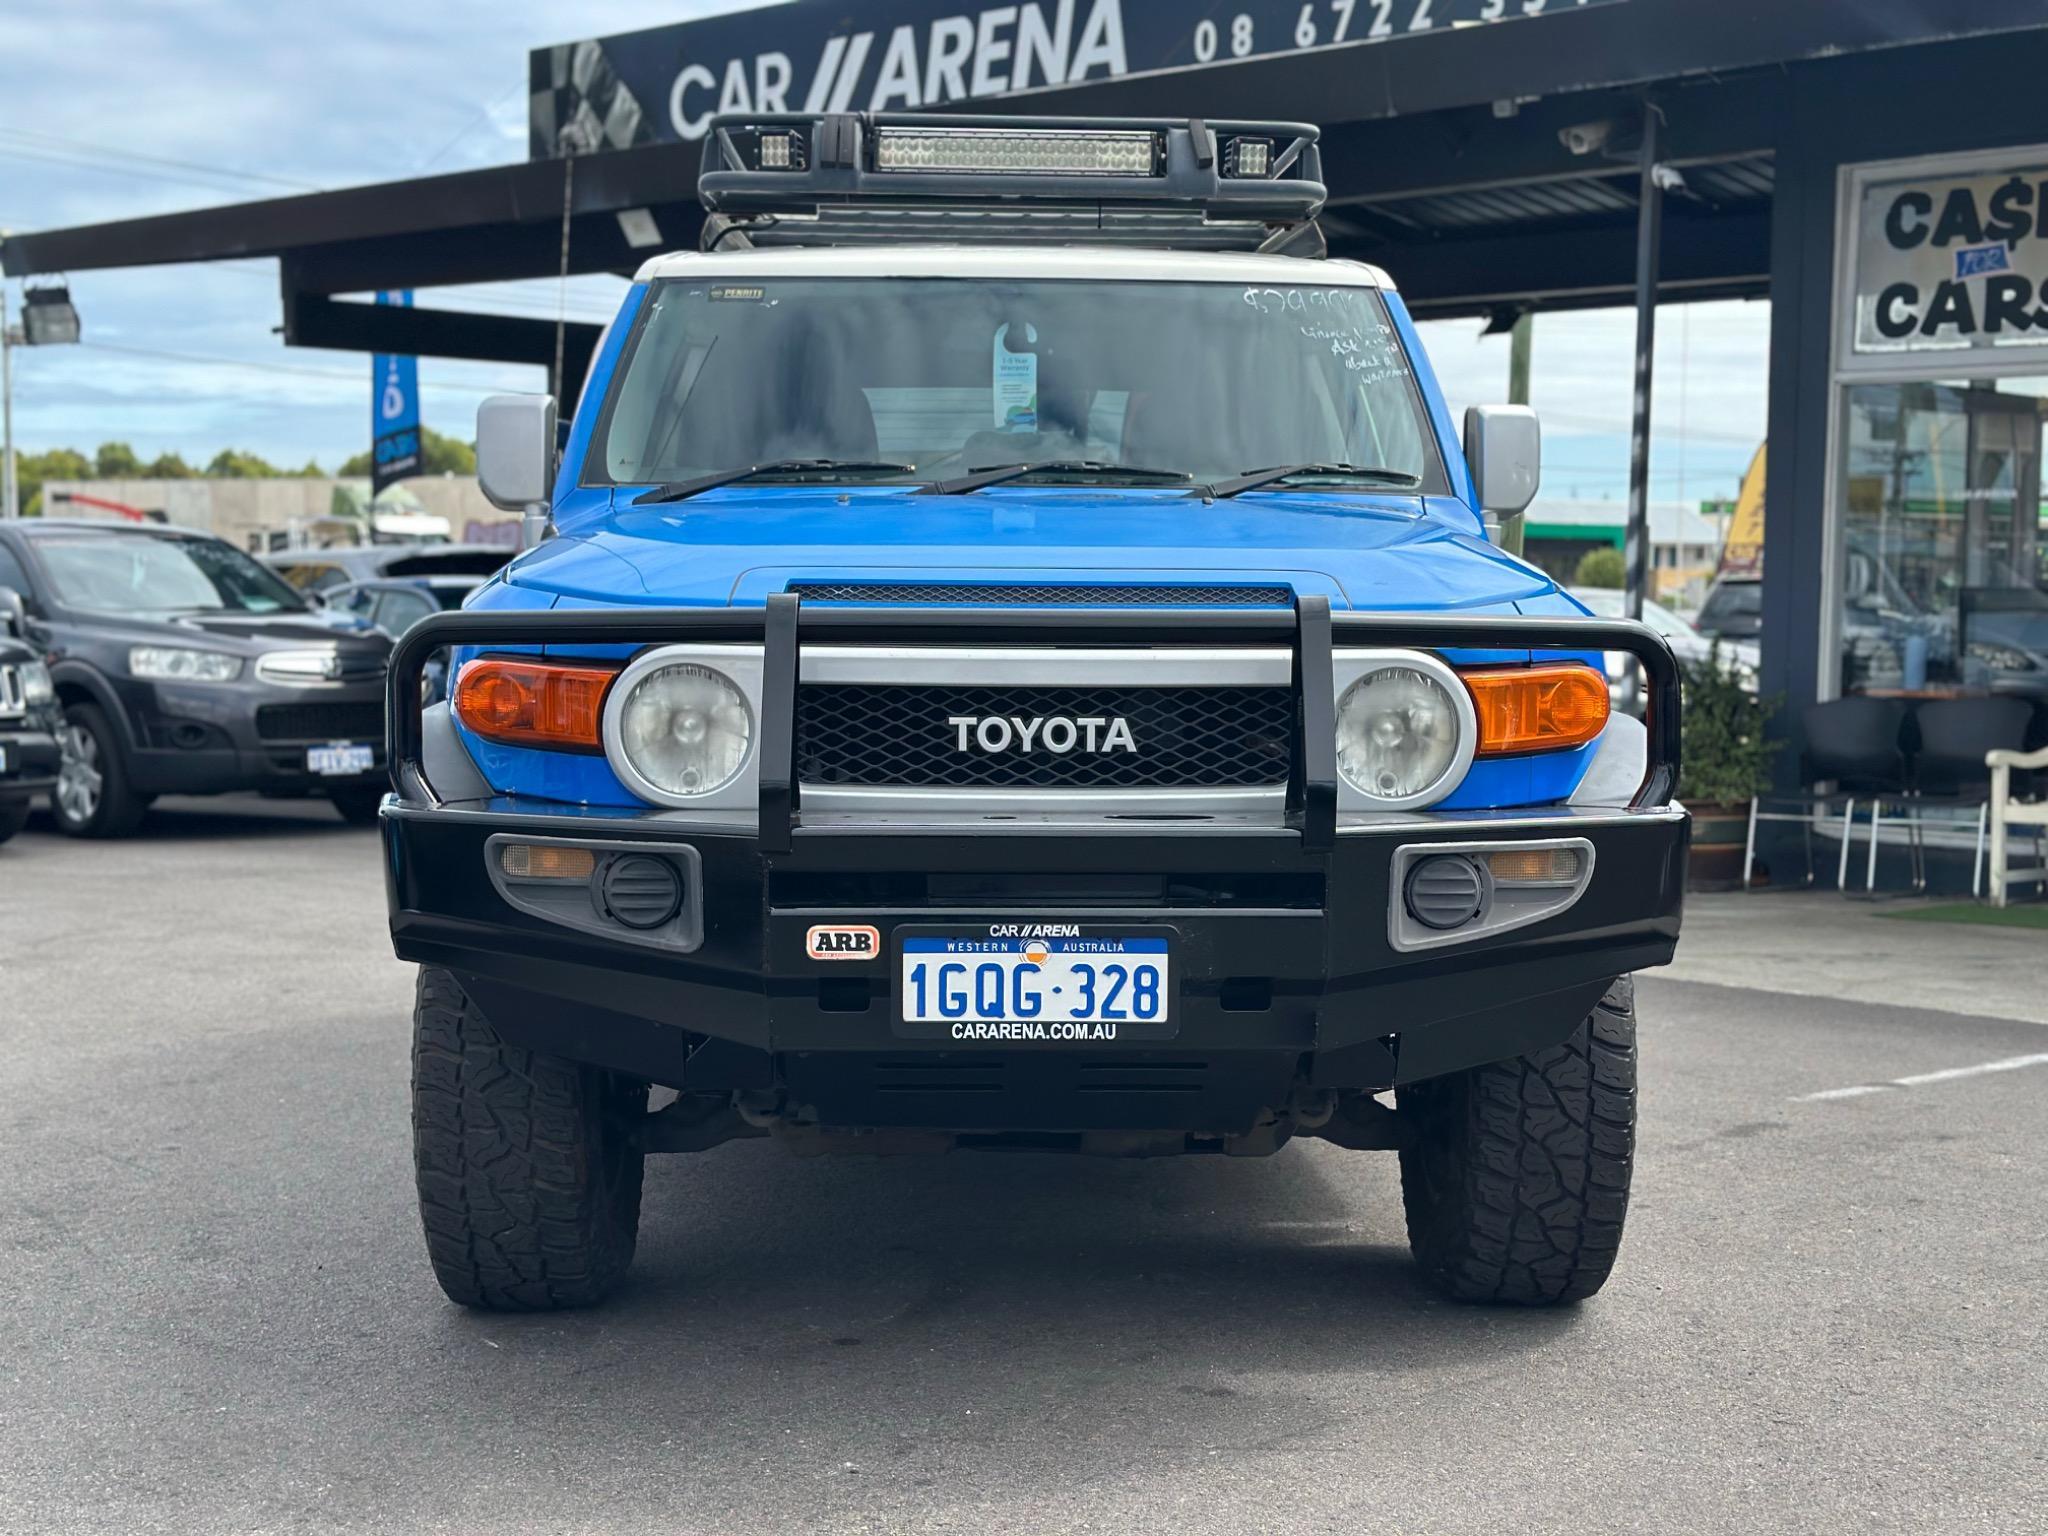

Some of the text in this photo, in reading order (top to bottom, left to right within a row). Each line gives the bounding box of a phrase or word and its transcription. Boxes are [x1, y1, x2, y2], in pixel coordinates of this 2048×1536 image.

[1194, 15, 1254, 62] 08
[1885, 176, 2048, 251] CA$
[1876, 274, 2048, 339] CAR
[948, 716, 1138, 753] TOYOTA
[815, 932, 872, 952] ARB
[947, 942, 1125, 953] WESTERN AUSTRALIA
[951, 1023, 1117, 1040] CARARENA.COM.AU
